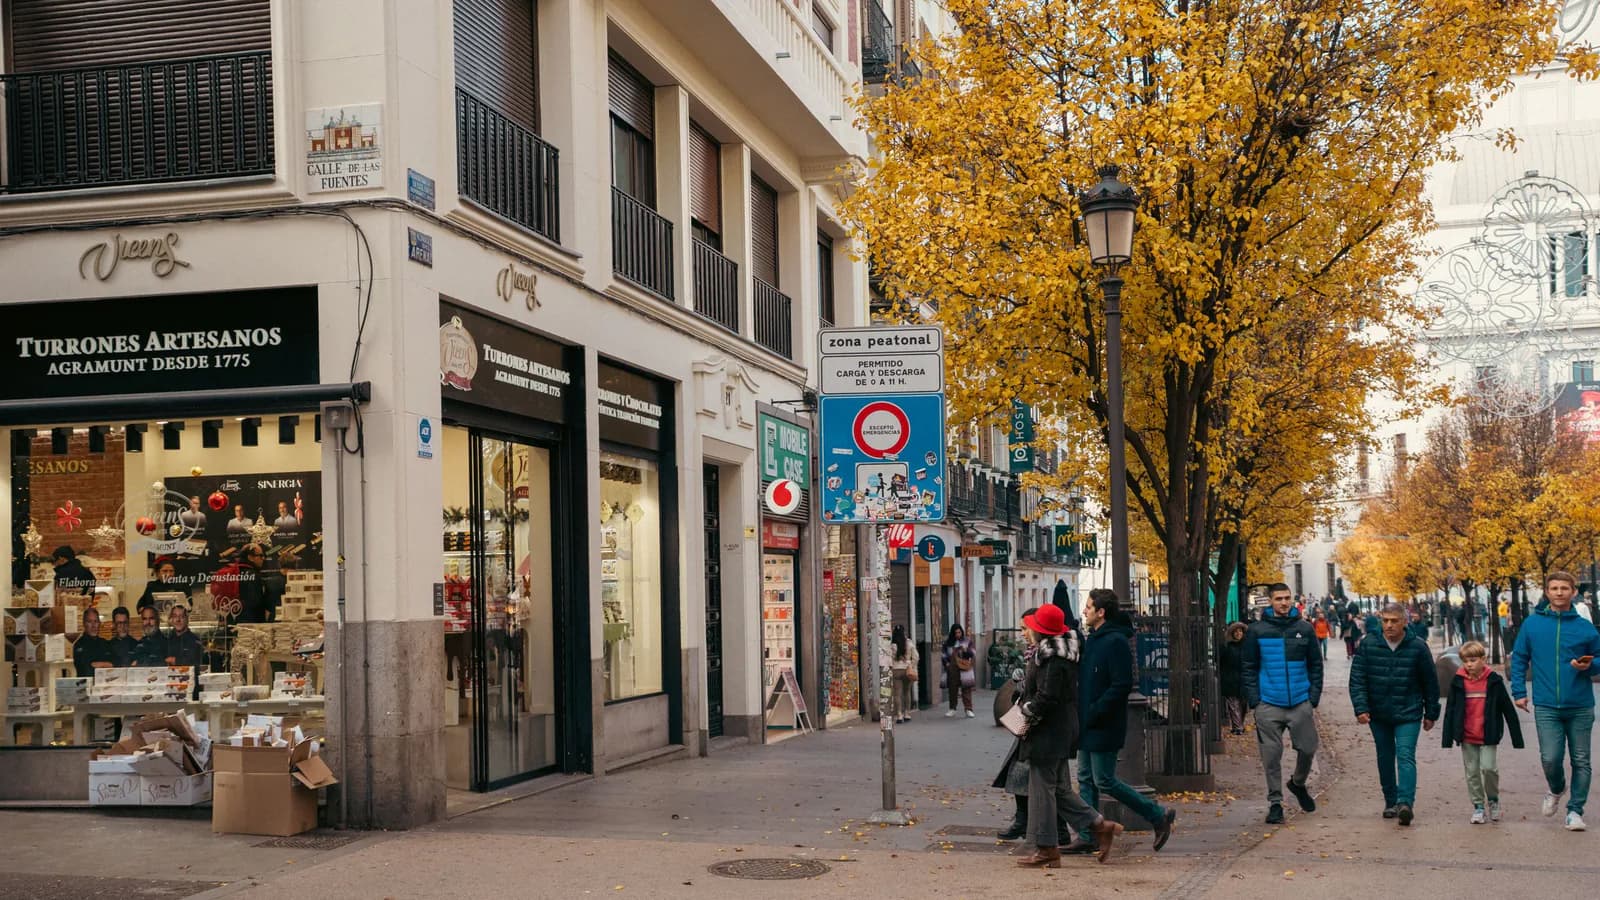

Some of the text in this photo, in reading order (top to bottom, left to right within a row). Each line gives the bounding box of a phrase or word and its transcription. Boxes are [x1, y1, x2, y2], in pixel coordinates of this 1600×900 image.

[307, 162, 380, 177] CALLE DE LAS
[321, 175, 368, 189] FUENTES
[79, 232, 191, 281] Vicens
[16, 327, 282, 358] TURRONES ARTESANOS
[829, 334, 931, 349] zona peatonal
[47, 353, 251, 376] AGRAMUNT DESDE 1775
[483, 343, 529, 372] TURRONES
[528, 361, 571, 385] ARTESANOS
[836, 370, 866, 378] CARGA
[878, 368, 926, 376] DESCARGA
[858, 360, 904, 368] PERMITIDO
[494, 369, 561, 397] AGRAMUNT DESDE 1775
[898, 377, 907, 385] H.
[1014, 397, 1025, 440] HOSTA
[780, 424, 807, 456] MOBILE
[783, 456, 804, 484] CASE
[888, 524, 913, 545] illy
[161, 574, 186, 584] Venta
[189, 576, 196, 586] y
[198, 571, 255, 583] Degustación
